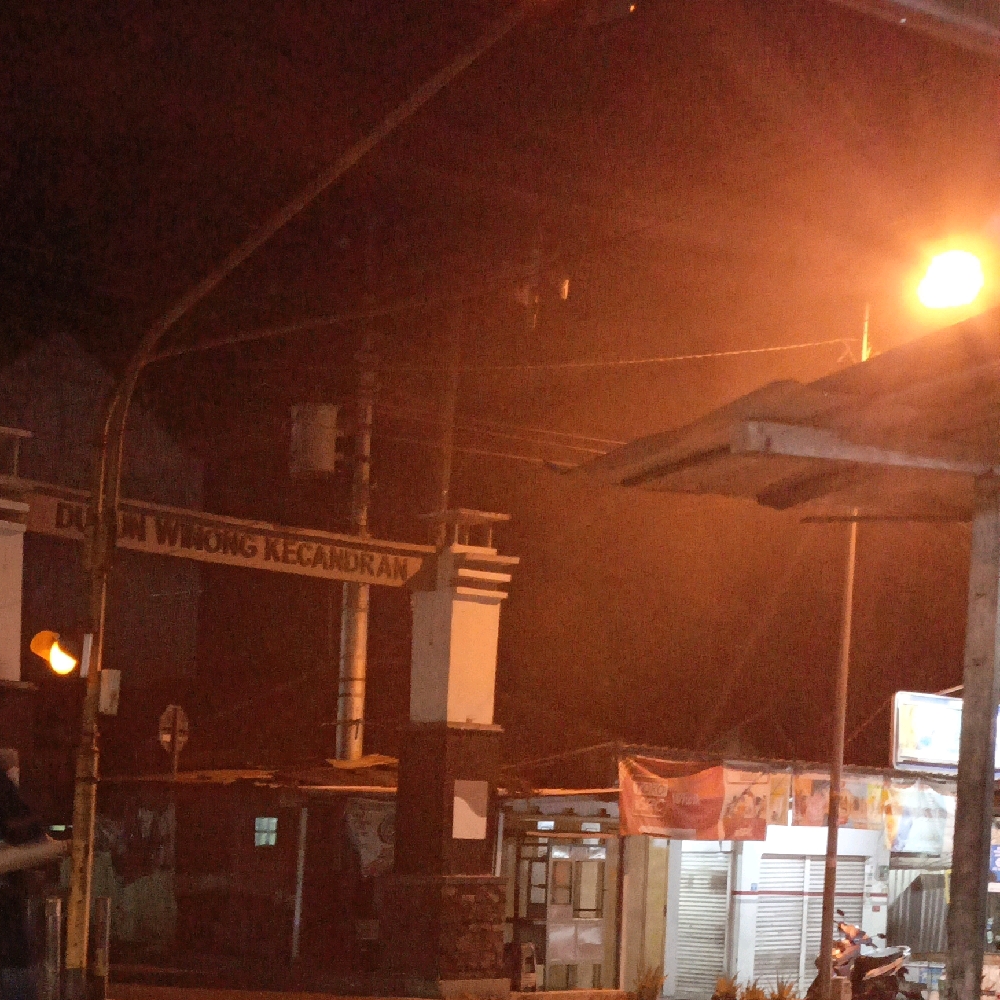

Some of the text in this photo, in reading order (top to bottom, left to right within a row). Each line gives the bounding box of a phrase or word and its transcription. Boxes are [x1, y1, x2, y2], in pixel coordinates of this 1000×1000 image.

[55, 502, 408, 580] DUN WINONG KECANDRAN
